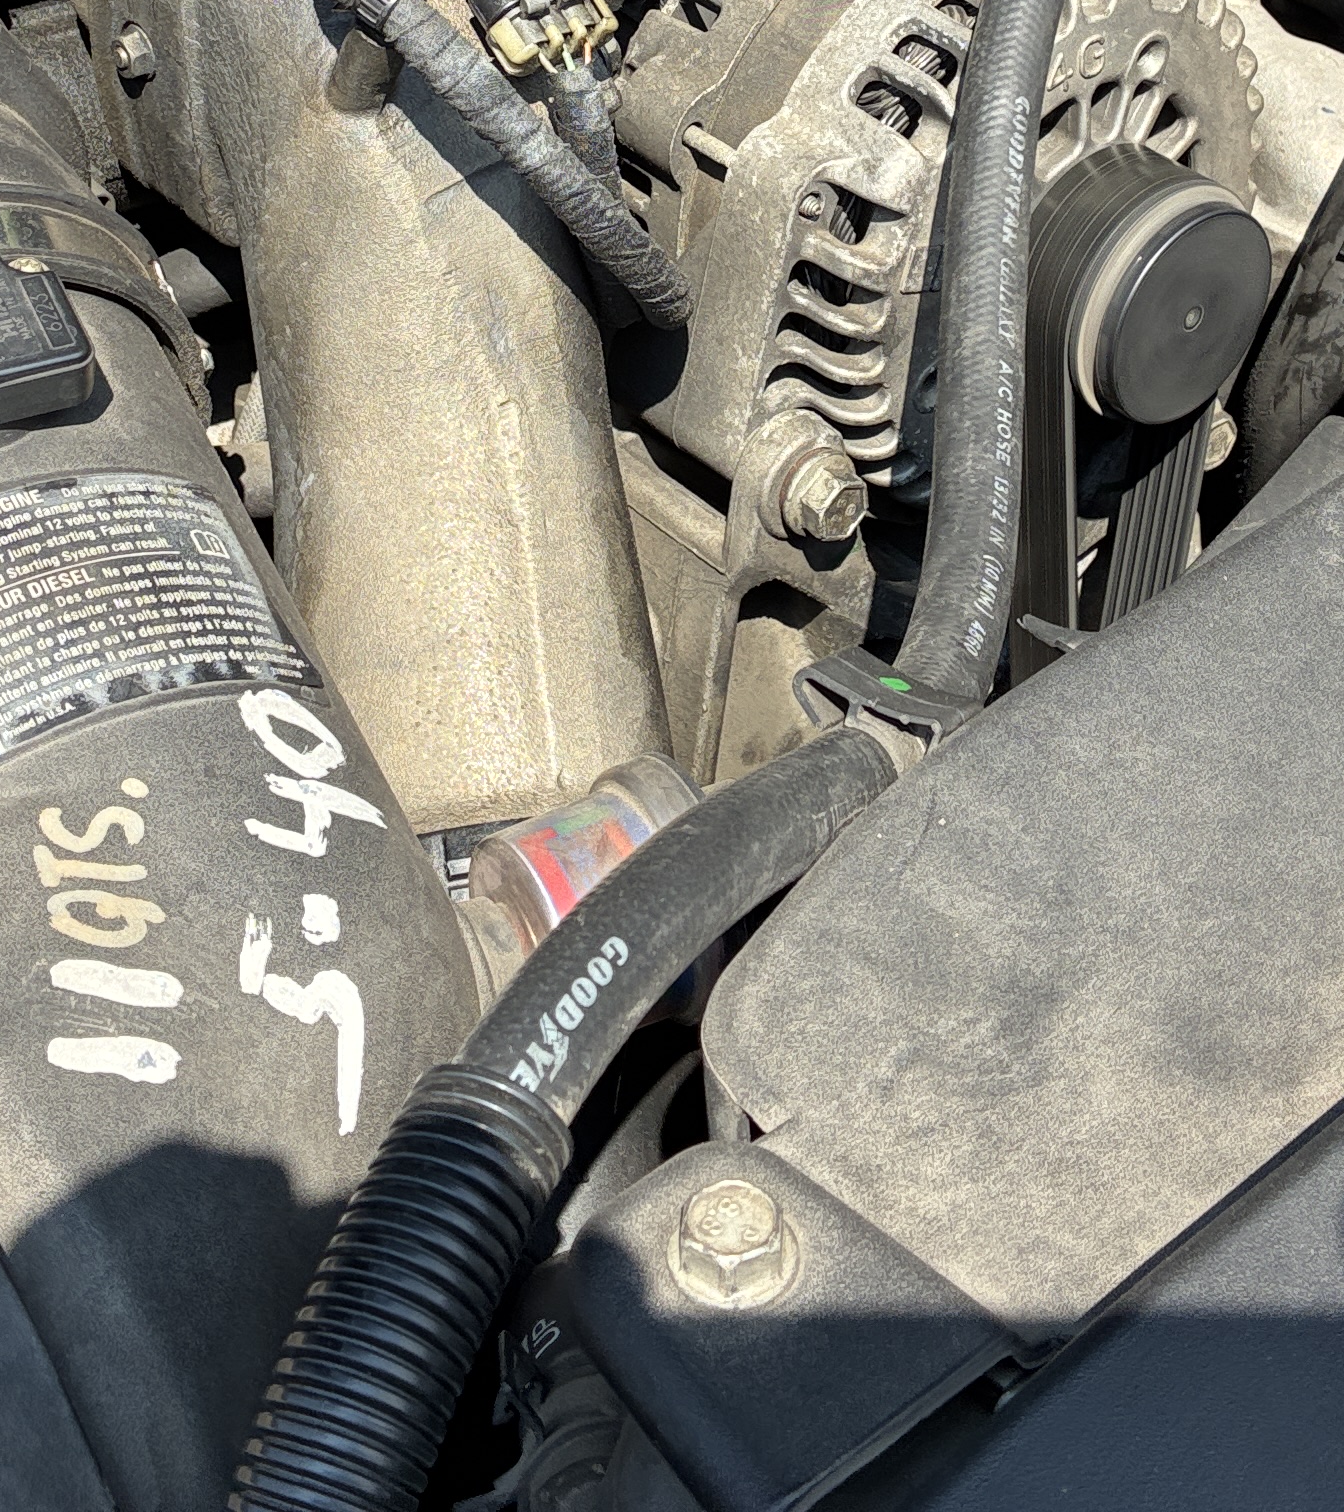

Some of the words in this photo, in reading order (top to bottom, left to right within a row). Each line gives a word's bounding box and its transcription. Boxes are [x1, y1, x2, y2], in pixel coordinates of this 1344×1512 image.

[11, 314, 37, 341] MADE
[996, 359, 1015, 401] A/C
[992, 410, 1014, 468] HOSE
[33, 501, 86, 520] damage
[87, 495, 111, 508] can
[988, 476, 1008, 522] 13/32
[45, 517, 64, 532] 12
[64, 510, 96, 528] volts
[96, 510, 112, 523] to
[100, 520, 143, 538] Failure
[988, 525, 1006, 550] IN
[6, 552, 61, 580] Starting
[61, 543, 110, 564] System
[111, 538, 135, 553] can
[25, 567, 97, 600] DIESEL
[101, 565, 121, 580] Ne
[122, 561, 145, 578] pas
[55, 590, 83, 609] Des
[83, 576, 154, 600] dommages
[56, 626, 88, 647] plus
[88, 618, 107, 635] de
[108, 613, 128, 629] 12
[128, 607, 161, 625] volts
[52, 638, 102, 664] charge
[32, 776, 167, 948] QTS.
[47, 959, 184, 1085] 11
